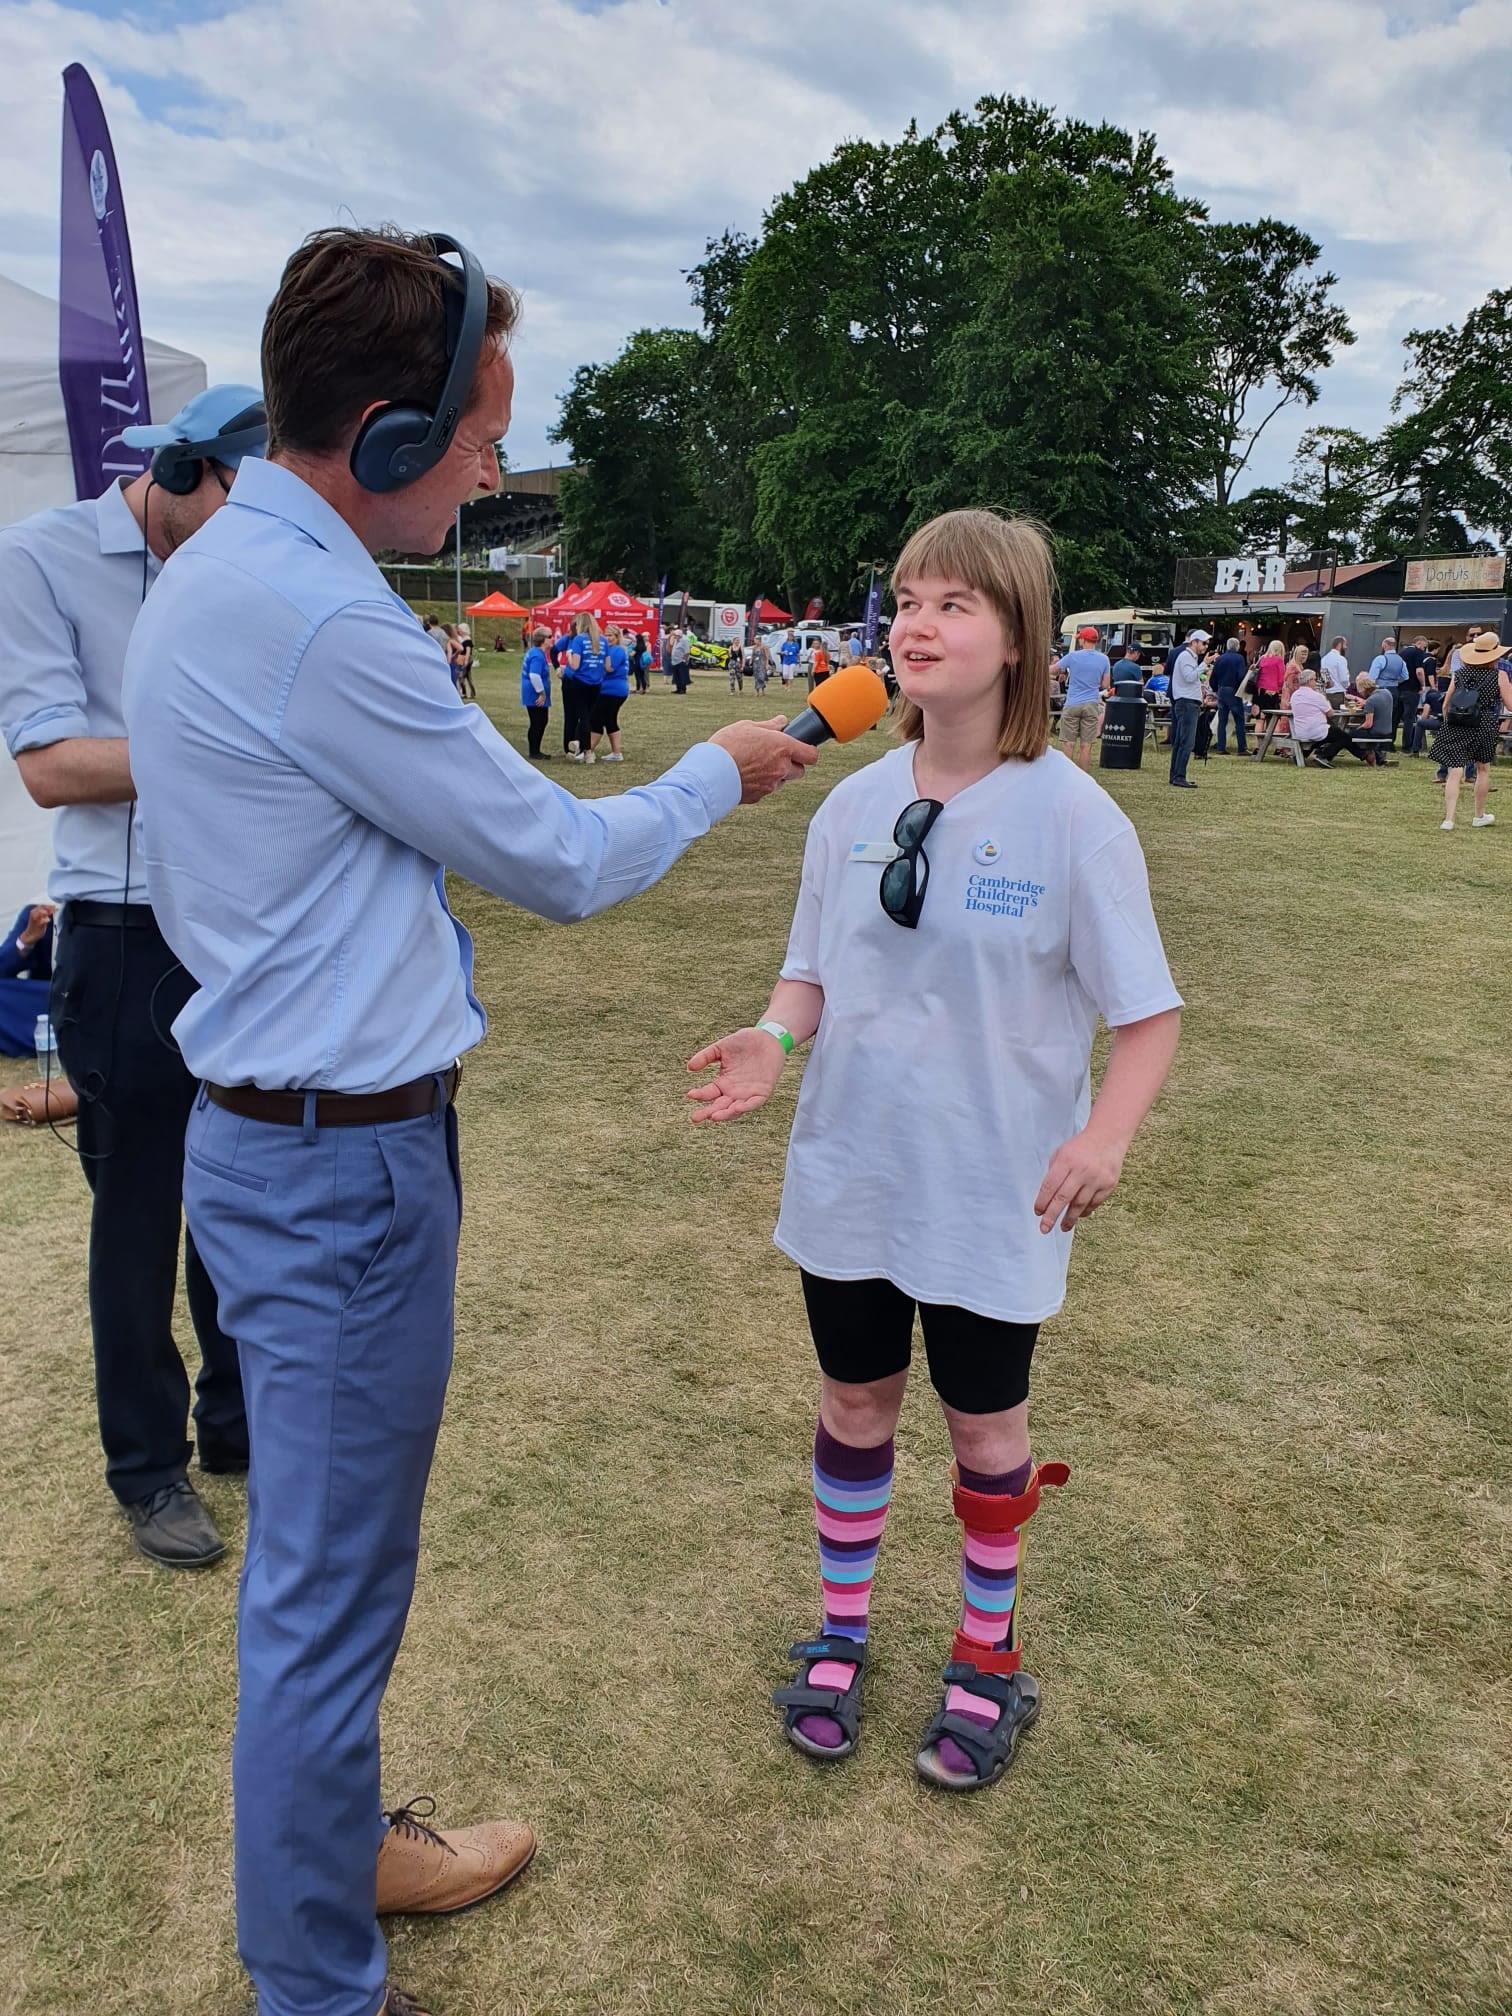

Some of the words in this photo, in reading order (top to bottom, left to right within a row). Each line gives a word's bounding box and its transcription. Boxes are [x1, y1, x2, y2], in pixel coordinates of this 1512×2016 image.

[1214, 556, 1287, 593] BAR
[966, 887, 1039, 907] Children's
[968, 874, 1046, 898] Cambridge
[965, 898, 1024, 918] Hospital
